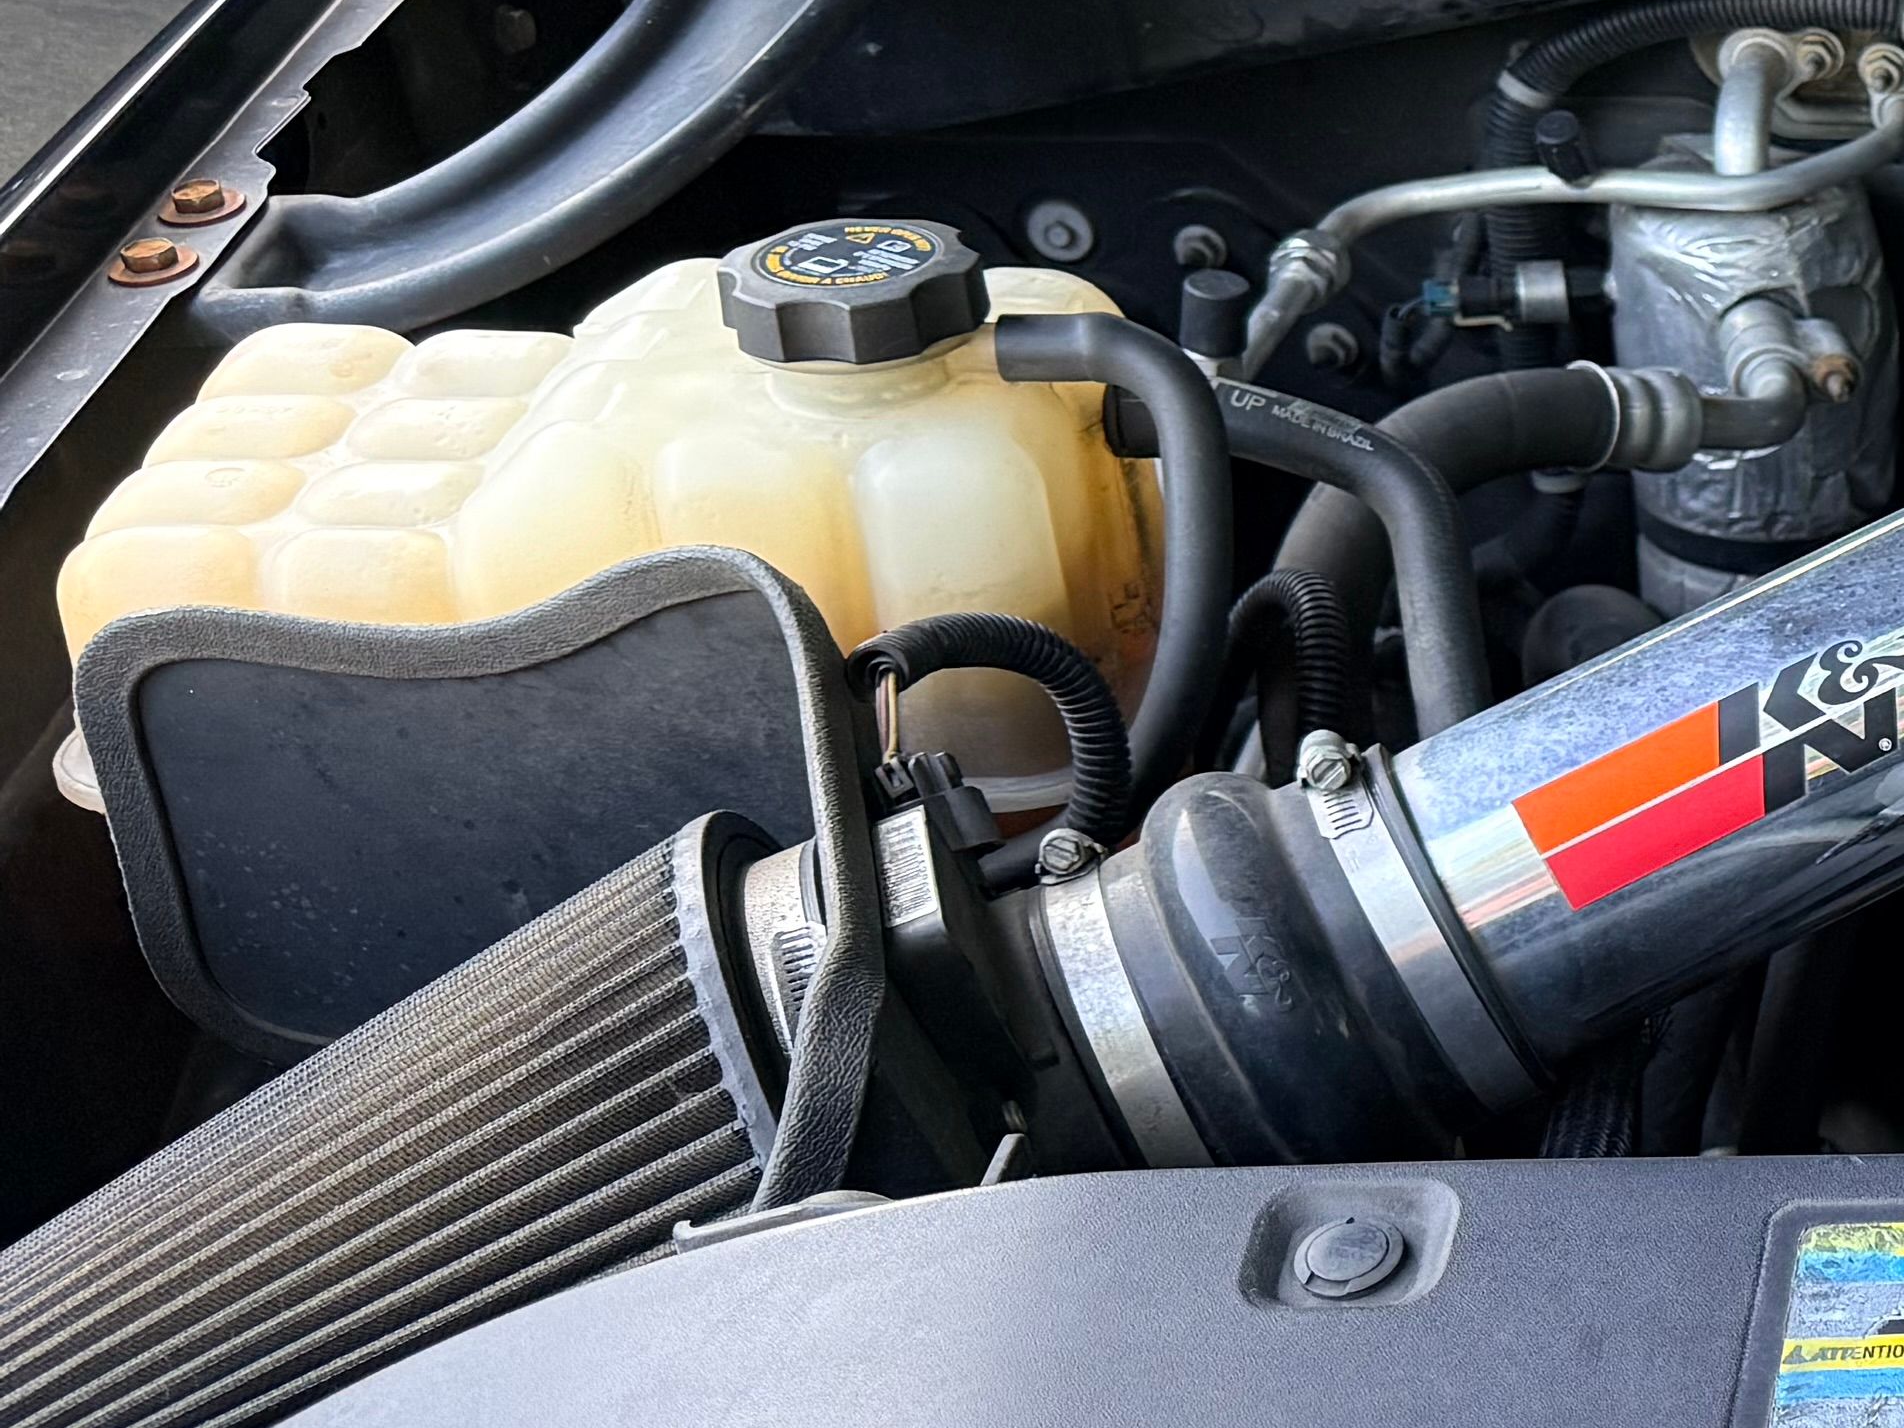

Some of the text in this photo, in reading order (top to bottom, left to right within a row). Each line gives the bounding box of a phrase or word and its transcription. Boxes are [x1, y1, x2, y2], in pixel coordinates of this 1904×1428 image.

[1230, 389, 1267, 410] UP
[1271, 405, 1311, 429] MADE
[1326, 426, 1375, 452] BRAZIL
